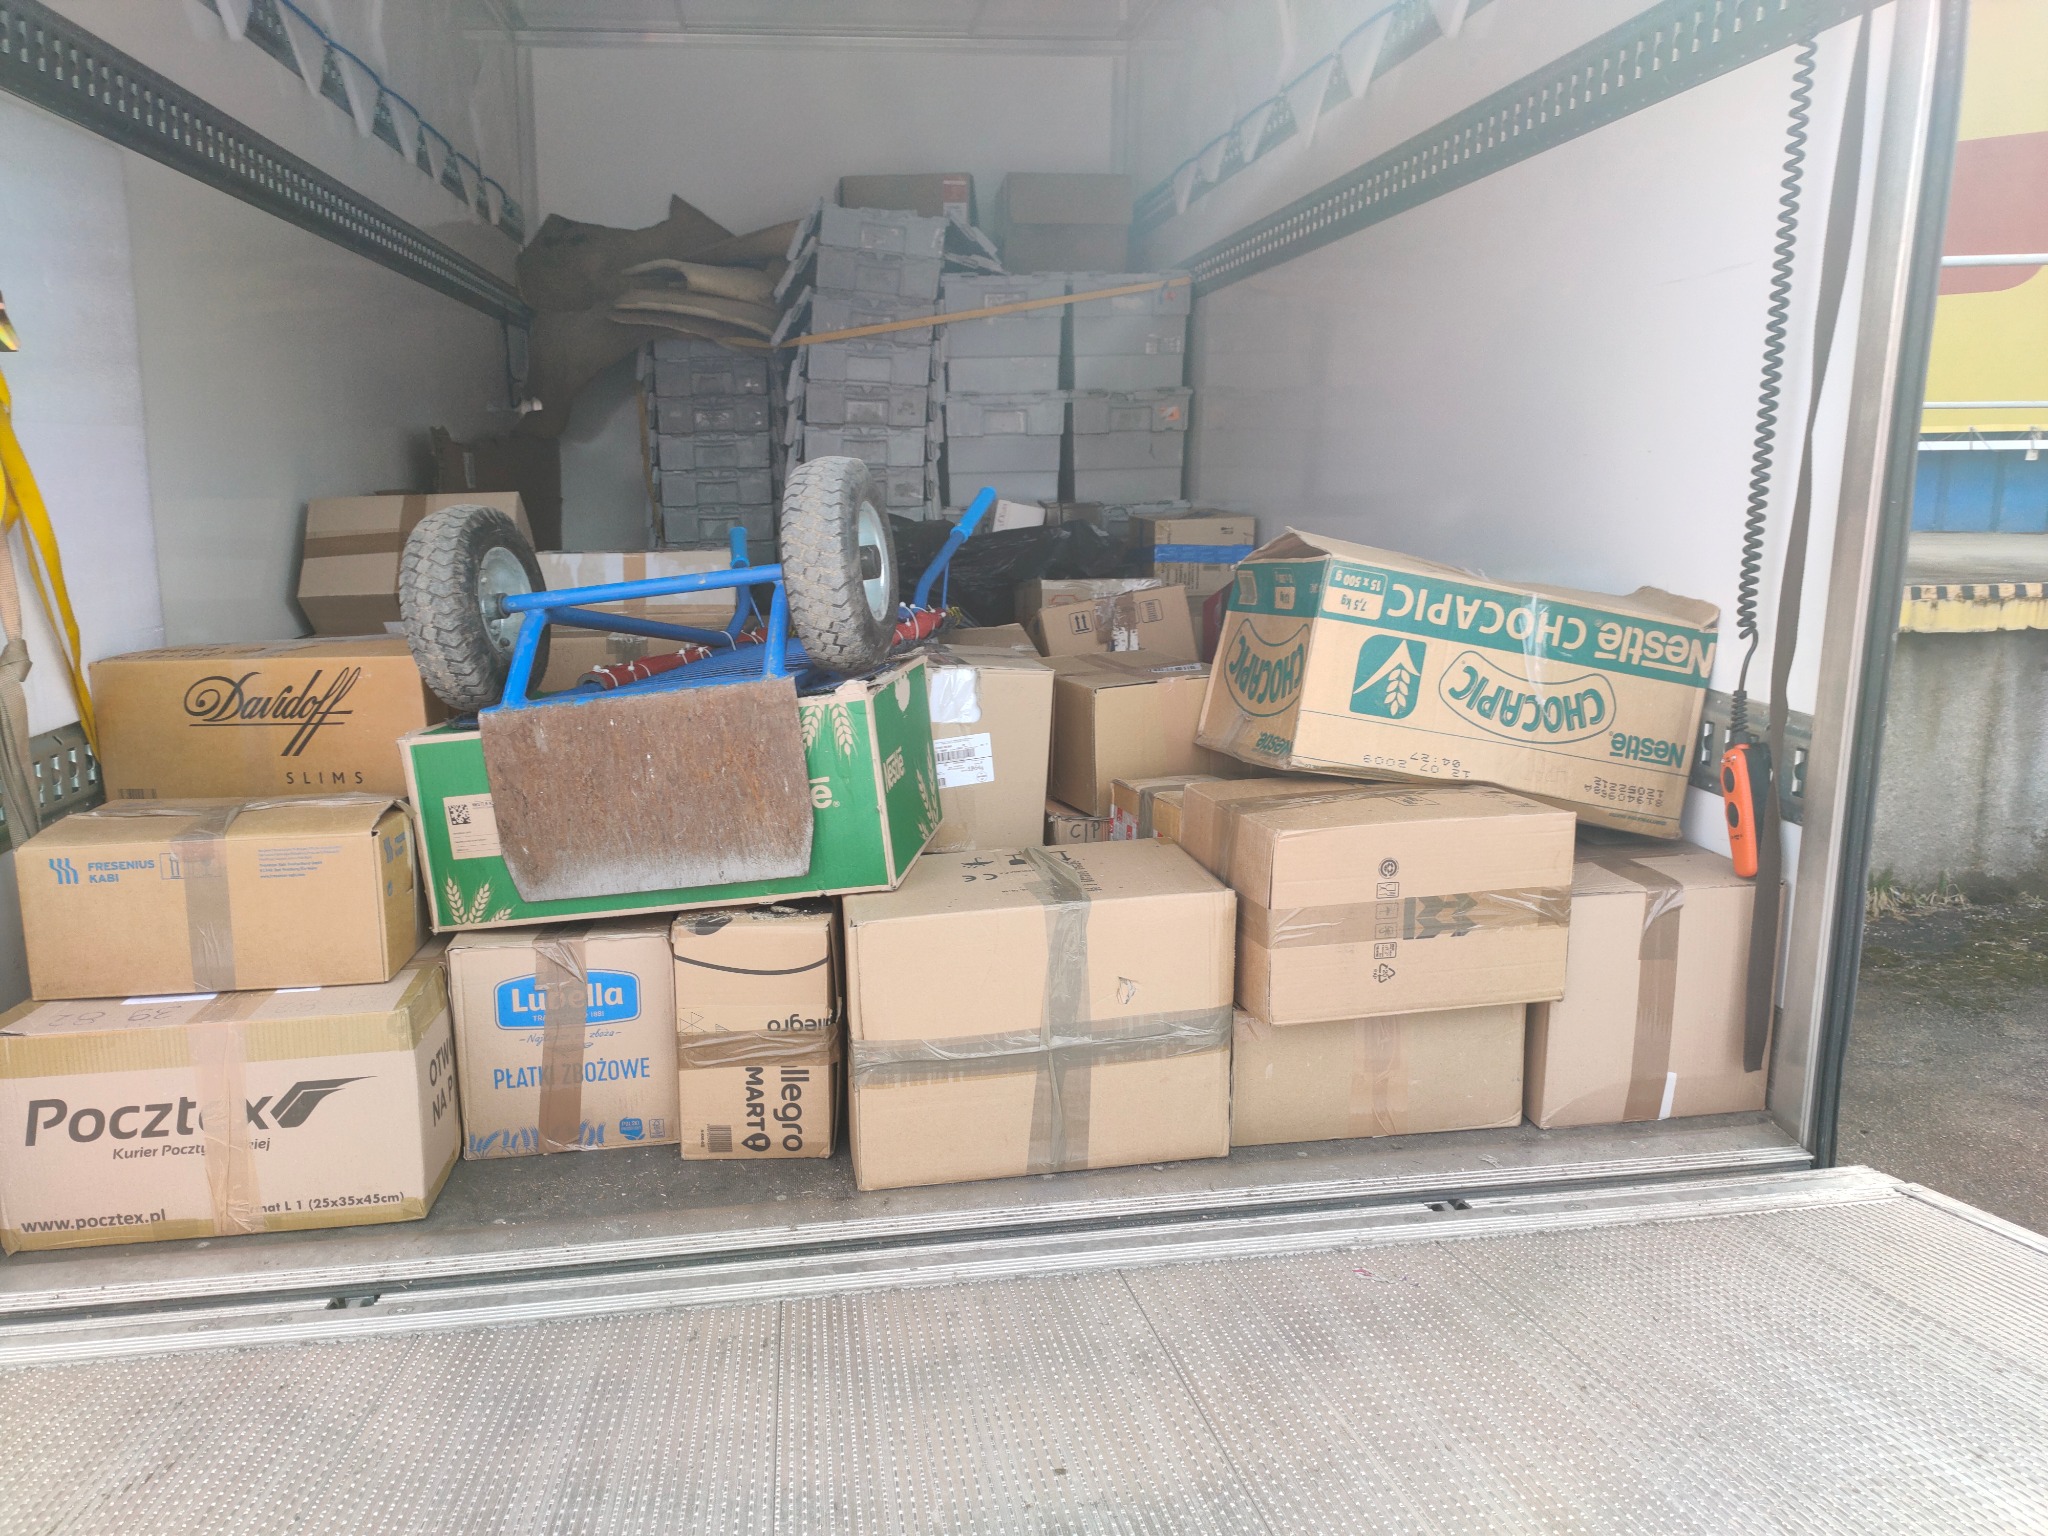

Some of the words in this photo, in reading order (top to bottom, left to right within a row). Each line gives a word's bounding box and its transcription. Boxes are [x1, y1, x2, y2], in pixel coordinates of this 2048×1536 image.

[1335, 570, 1342, 581] g
[1343, 573, 1361, 588] 500
[1363, 578, 1370, 587] x
[1371, 579, 1382, 591] 15
[1340, 594, 1352, 609] kg
[1354, 599, 1368, 611] 7,5
[1386, 584, 1588, 650] CHOCAPIC
[1229, 635, 1304, 704] CHOCAPIC
[1447, 665, 1606, 734] CHOCAPIC
[184, 666, 362, 756] Davidoff
[286, 771, 364, 785] SLIMS
[87, 859, 155, 871] FRESENIUS
[89, 874, 119, 883] KABI
[432, 1087, 448, 1127] NA
[773, 1065, 810, 1152] llegro
[25, 1095, 273, 1147] Pocztx
[112, 1145, 158, 1161] Kurier
[284, 1201, 292, 1211] L
[296, 1200, 302, 1210] 1
[308, 1190, 405, 1212] (25x35x45cm)
[21, 1208, 167, 1233] www.pocztex.pl
